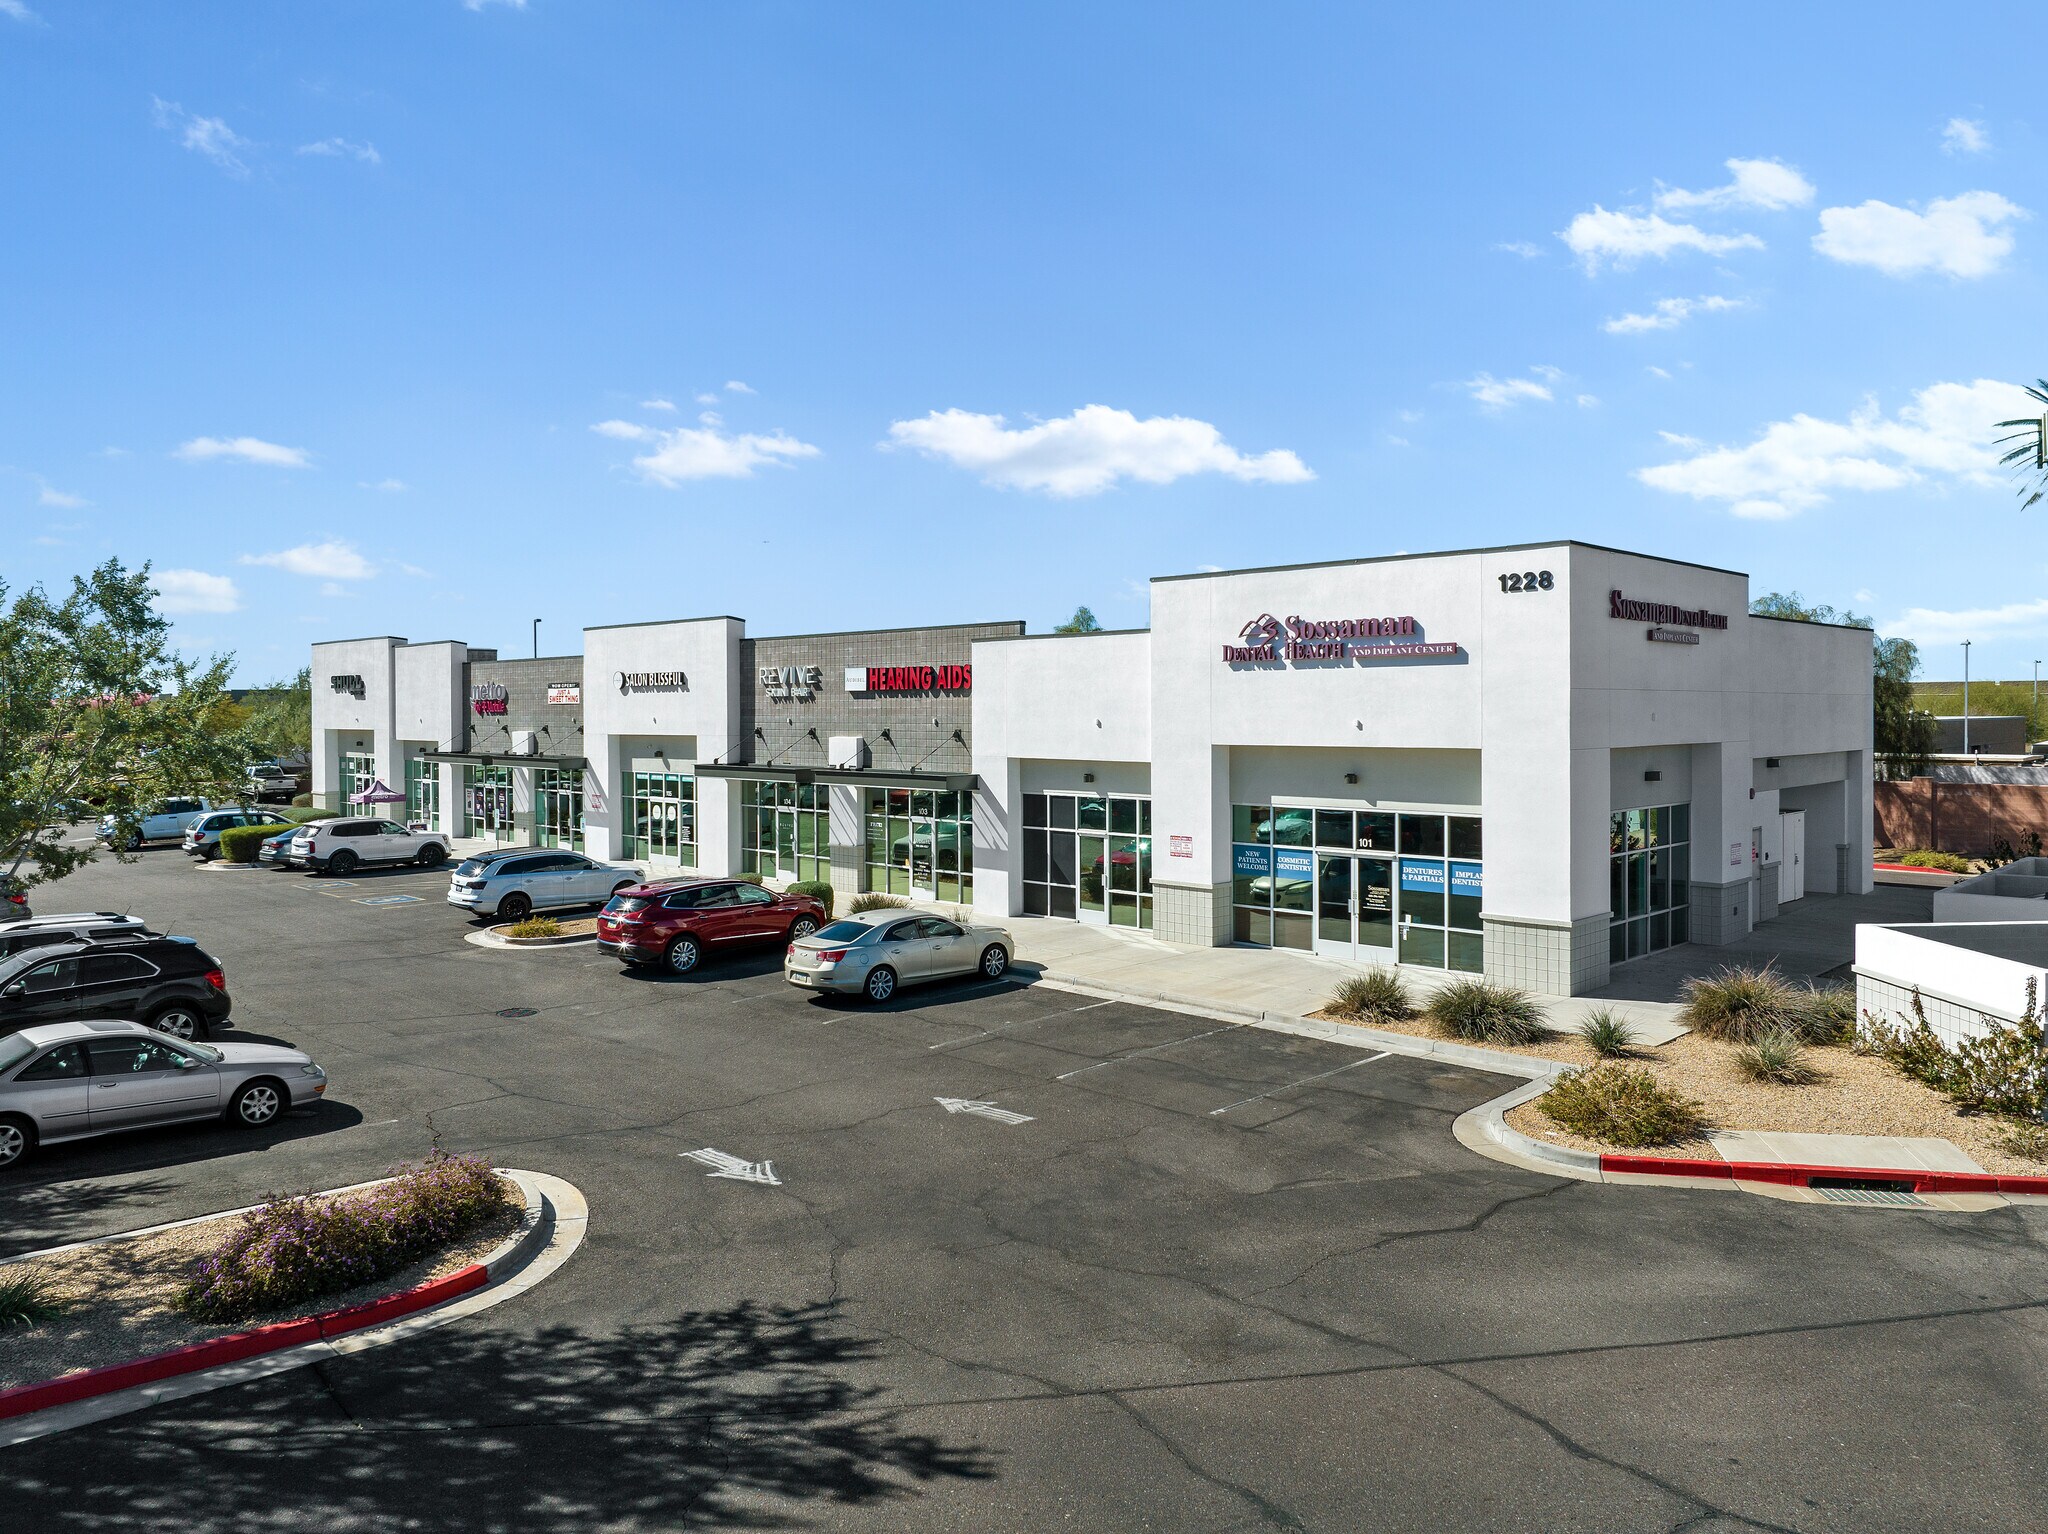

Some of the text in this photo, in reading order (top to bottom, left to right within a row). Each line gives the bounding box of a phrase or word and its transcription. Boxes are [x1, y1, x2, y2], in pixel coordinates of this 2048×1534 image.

[1498, 570, 1552, 592] 1228
[1610, 589, 1674, 625] Sossaman
[1284, 615, 1415, 642] Sossaman
[625, 671, 683, 686] SALON BLISSFUL
[759, 665, 818, 685] REVIVE
[869, 664, 972, 690] HEARING AIDS
[791, 687, 811, 697] BAR
[918, 807, 929, 815] 103
[1358, 838, 1372, 848] 101
[1238, 856, 1268, 864] PATIENTS
[1277, 856, 1311, 865] COSMETIC
[1237, 863, 1269, 871] WELCOME
[1277, 863, 1312, 872] DENTISTRY
[1402, 866, 1443, 876] DENTURES
[1408, 874, 1444, 884] PARTIALS
